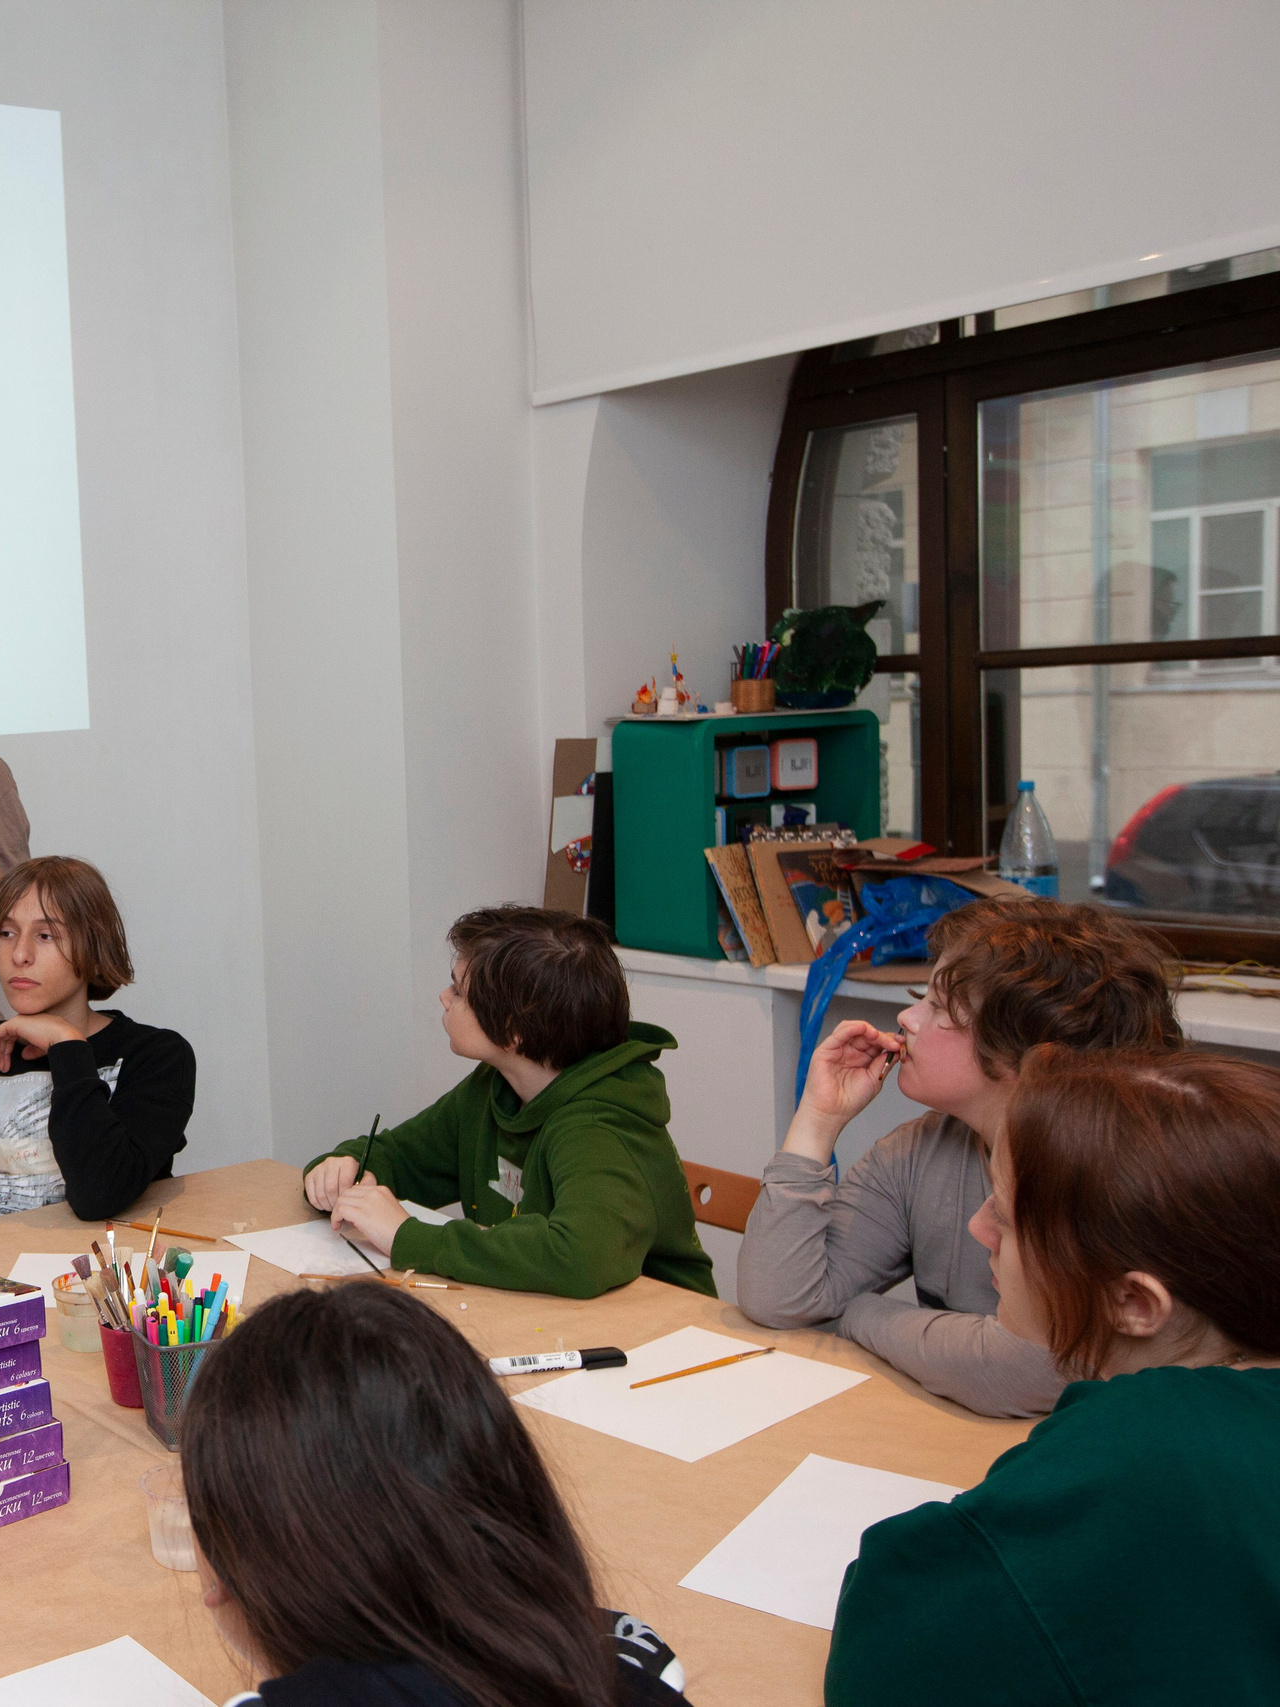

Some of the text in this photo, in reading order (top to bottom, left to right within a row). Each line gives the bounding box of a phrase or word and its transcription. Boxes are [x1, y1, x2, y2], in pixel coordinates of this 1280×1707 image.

[14, 1323, 21, 1335] 6
[10, 1374, 15, 1382] 6
[15, 1368, 37, 1380] colours
[20, 1409, 27, 1421] 6
[22, 1450, 35, 1466] 12
[34, 1451, 55, 1462] цветов
[31, 1491, 44, 1507] 12
[43, 1491, 63, 1502] цветов
